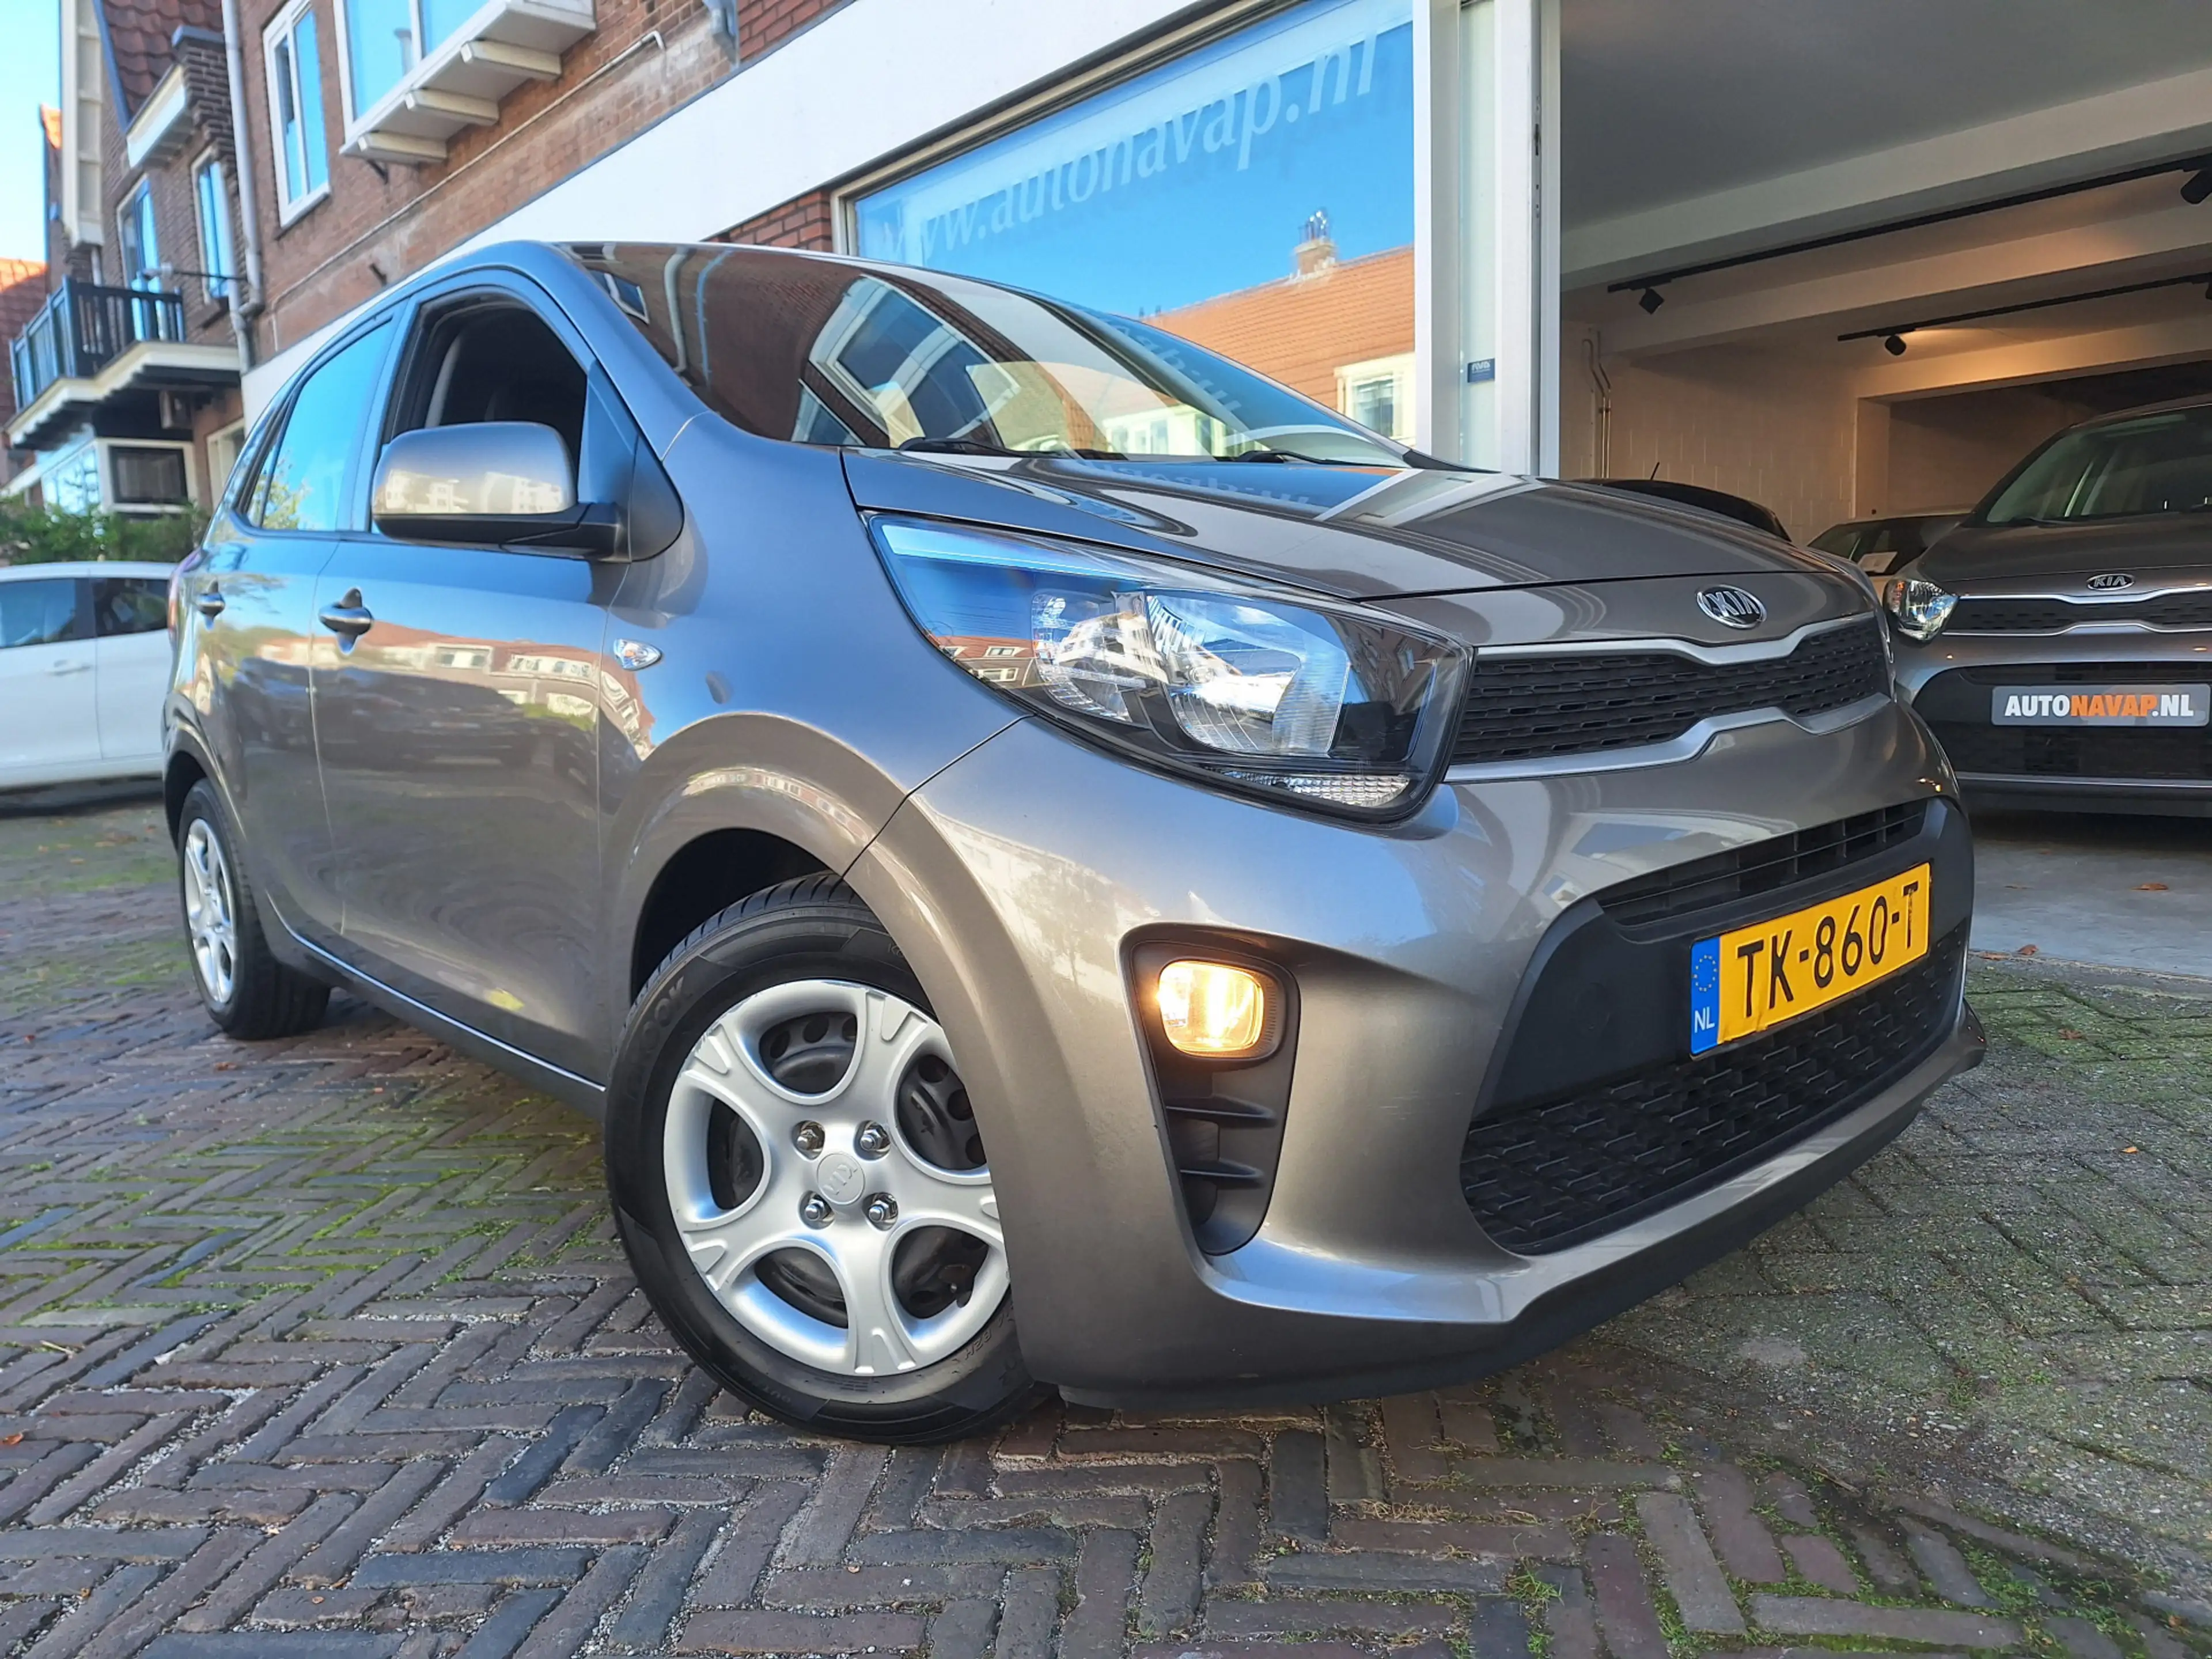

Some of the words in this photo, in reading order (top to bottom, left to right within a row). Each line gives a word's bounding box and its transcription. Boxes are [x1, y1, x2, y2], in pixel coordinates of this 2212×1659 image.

[2093, 576, 2127, 588] KIA
[1703, 590, 1760, 617] KIA
[2005, 694, 2194, 717] AUTONAVAP.NL
[1737, 881, 1919, 1018] TK-860-T
[1694, 1006, 1715, 1033] NL
